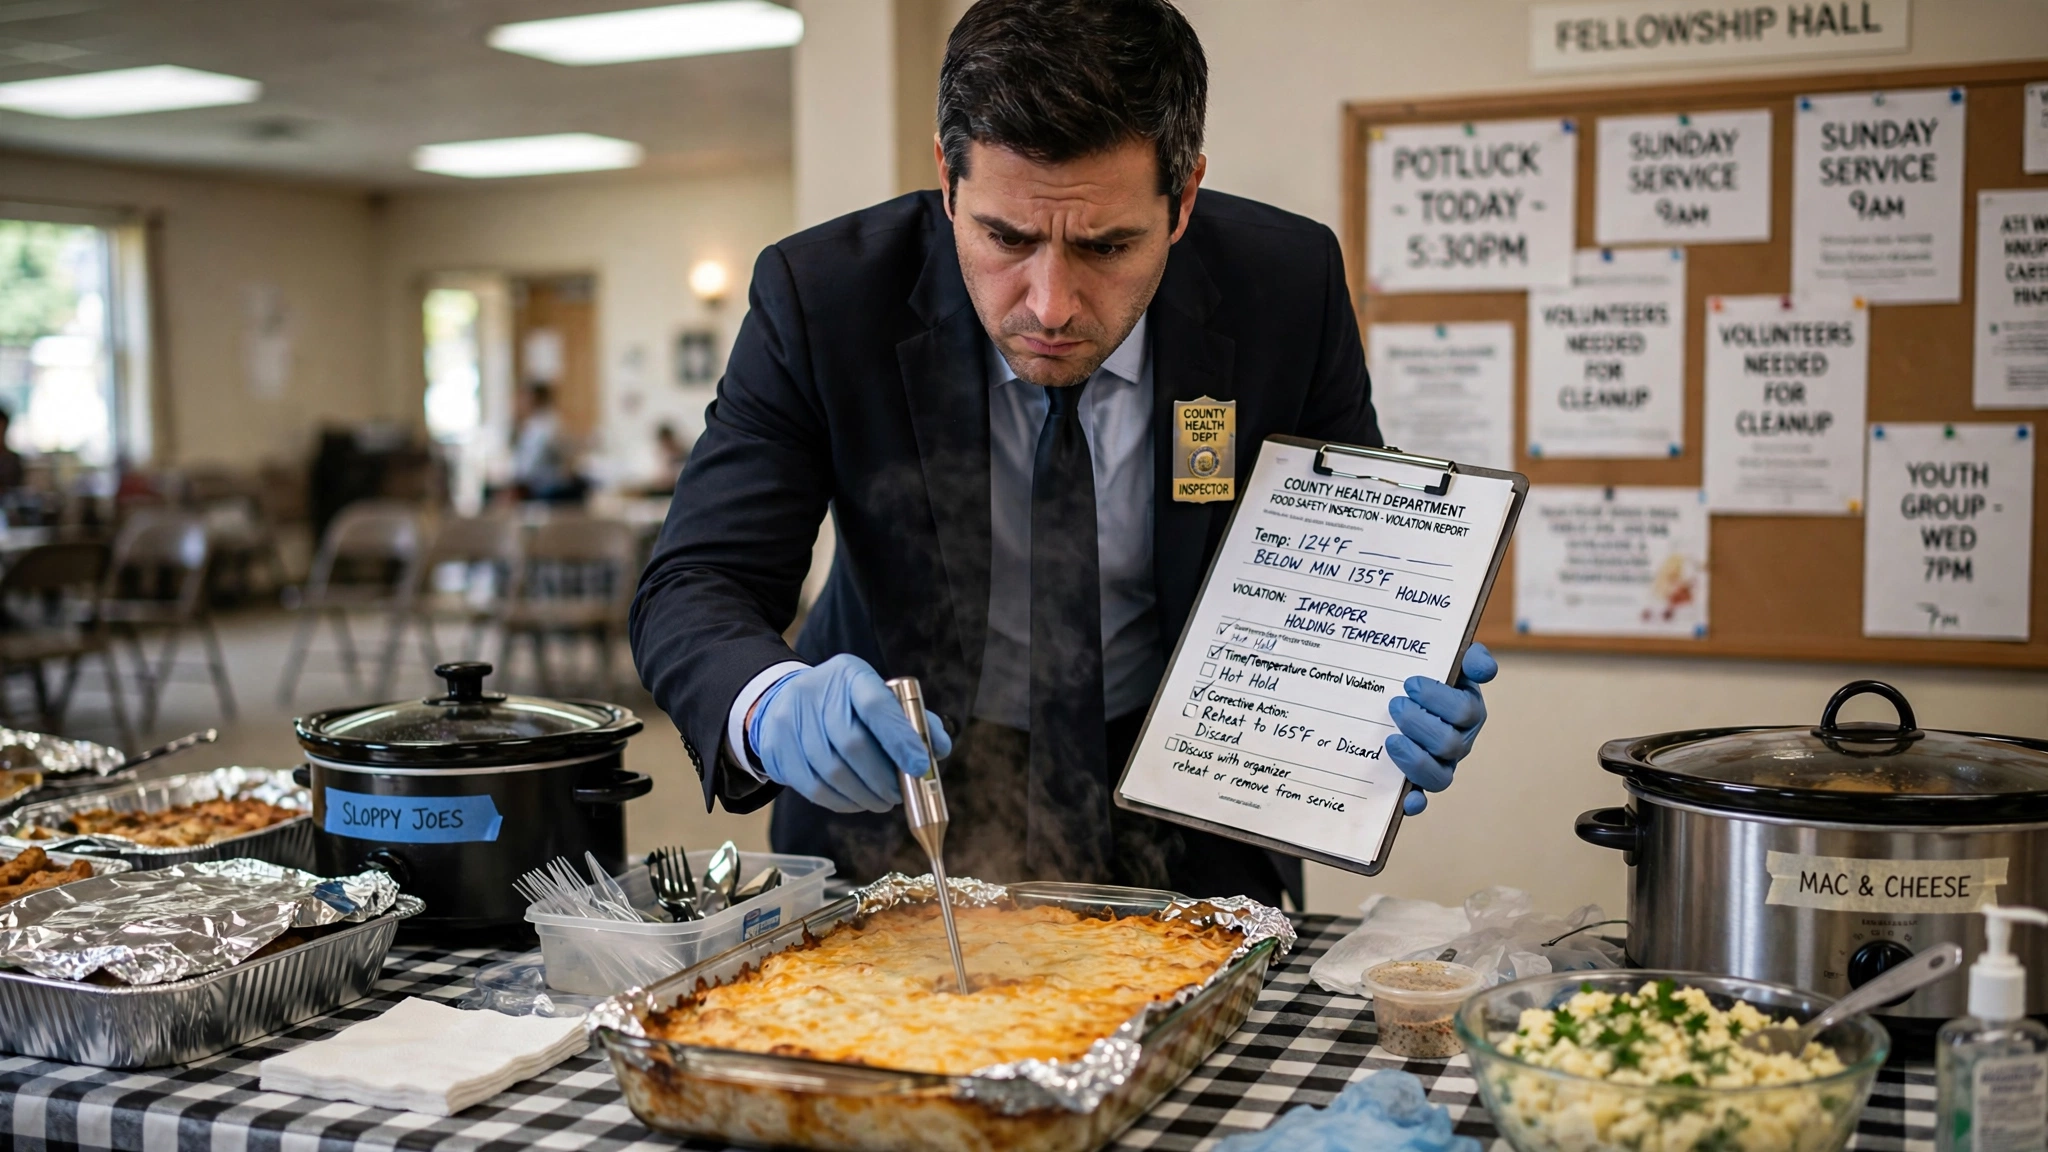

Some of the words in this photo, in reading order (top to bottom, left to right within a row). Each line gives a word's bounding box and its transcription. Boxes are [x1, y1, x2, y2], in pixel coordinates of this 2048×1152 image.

[1556, 6, 1777, 52] FELLOWSHIP
[1787, 1, 1882, 38] HALL
[1629, 128, 1739, 161] SUNDAY
[1821, 118, 1938, 151] SUNDAY
[1393, 142, 1540, 180] POTLUCK
[1819, 153, 1937, 187] SERVICE
[1629, 162, 1738, 193] SERVICE
[1416, 188, 1523, 223] TODAY
[1655, 198, 1709, 226] 9AM
[1849, 190, 1905, 220] 9AM
[1407, 232, 1528, 268] 5:30PM
[1541, 303, 1669, 327] VOLUNTEERS
[1566, 333, 1646, 355] NEEDED
[1719, 322, 1854, 348] VOLUNTEERS
[1585, 360, 1624, 382] FOR
[1744, 353, 1828, 377] NEEDED
[1558, 389, 1650, 412] CLEANUP
[1764, 382, 1806, 406] FOR
[1184, 408, 1226, 419] COUNTY
[1185, 420, 1225, 431] HEALTH
[1735, 411, 1833, 437] CLEANUP
[1192, 432, 1218, 442] DEPT
[1906, 461, 1989, 488] YOUTH
[1178, 483, 1229, 496] INSPECTOR
[1284, 477, 1333, 497] COUNTY
[1335, 485, 1381, 504] HEALTH
[1383, 494, 1466, 518] DEPARTMENT
[1270, 494, 1295, 507] FOOD
[1295, 498, 1328, 513] SAFETY
[1329, 503, 1380, 522] INSPECTION
[1385, 514, 1432, 533] VIOLATION
[1433, 523, 1470, 538] REPORT
[1901, 493, 1986, 520] GROUP
[1254, 527, 1291, 548] Temp:
[1298, 533, 1352, 555] 124°F
[1920, 525, 1977, 551] WED
[1253, 549, 1303, 570] BELOW
[1308, 561, 1340, 577] MIN
[1348, 566, 1394, 586] 135°F
[1395, 586, 1450, 609] HOLDING
[1923, 556, 1974, 582] 7PM
[1233, 582, 1288, 604] VIOLATION:
[1294, 597, 1367, 624] IMPROPER
[1284, 614, 1335, 636] HOLDING
[1342, 625, 1430, 655] TEMPERATURE
[1219, 667, 1244, 684] Hot
[1249, 674, 1279, 691] Hold
[1225, 649, 1307, 677] Time/Temperature
[1309, 668, 1343, 684] Control
[1345, 676, 1385, 694] Violation
[1207, 690, 1254, 711] Corrective
[1256, 704, 1289, 719] Action:
[1195, 723, 1243, 745] Discard
[1201, 706, 1246, 727] Reheat
[1254, 717, 1266, 733] to
[1273, 723, 1315, 742] 165°F
[1317, 737, 1332, 748] or
[1336, 737, 1383, 761] Discard
[1179, 740, 1213, 760] Discuss
[1217, 751, 1239, 766] with
[1243, 758, 1291, 779] organizer
[1172, 760, 1209, 777] reheat
[1213, 771, 1227, 781] or
[1230, 776, 1269, 794] remove
[1275, 784, 1301, 801] from
[1306, 794, 1345, 813] service
[343, 801, 401, 829] SLOPPY
[412, 807, 463, 830] JOES
[1799, 871, 1849, 896] MAC
[1858, 874, 1874, 897] &
[1885, 875, 1971, 898] CHEESE
